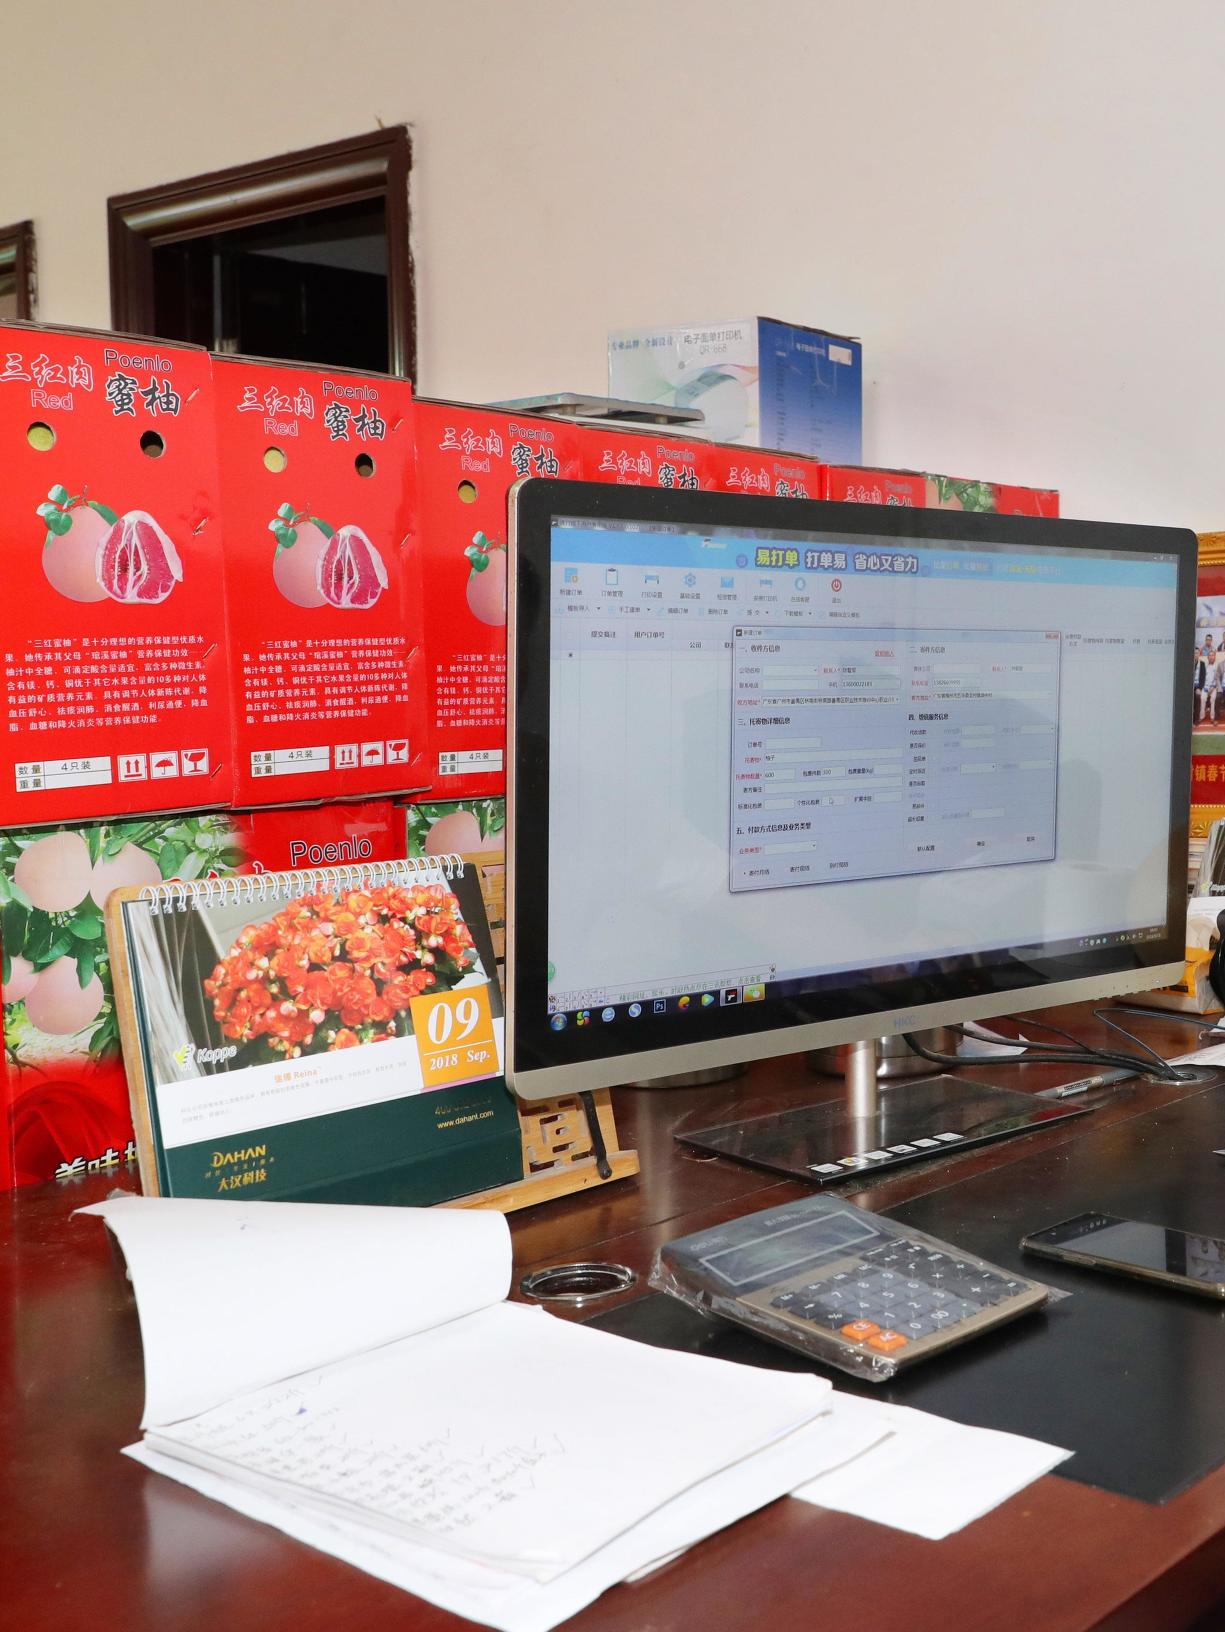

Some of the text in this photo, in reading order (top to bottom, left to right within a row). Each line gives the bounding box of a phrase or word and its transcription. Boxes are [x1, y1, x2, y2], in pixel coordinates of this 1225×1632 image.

[104, 348, 173, 372] Poenlo
[0, 353, 181, 417] 三红肉 蜜柚
[322, 380, 379, 401] Poenlo
[31, 389, 74, 411] Red
[237, 386, 386, 441] 三红肉 蜜柚
[263, 417, 298, 436] Red
[508, 424, 555, 443] Poenlo
[439, 428, 560, 478] 三红肉 蜜柚
[461, 456, 490, 473] Red
[598, 451, 699, 491] 三红肉 蜜柚
[726, 467, 771, 492] 三红肉
[756, 549, 799, 567] 易打单
[806, 551, 847, 569] 打单易
[854, 553, 919, 572] 省心又省力
[689, 641, 702, 649] 公司
[253, 752, 272, 763] 数量
[288, 750, 313, 759] 4只装
[469, 752, 489, 760] 4只装
[18, 763, 42, 776] 数量
[61, 760, 91, 771] 4只装
[254, 764, 273, 775] 重量
[19, 778, 42, 789] 重量
[289, 834, 373, 866] Poenlo
[655, 1002, 664, 1010] Ps
[427, 997, 480, 1045] 09
[430, 1049, 491, 1071] 2018 Sep.
[210, 1144, 266, 1168] DAHAN
[217, 1168, 268, 1193] 大汉科技
